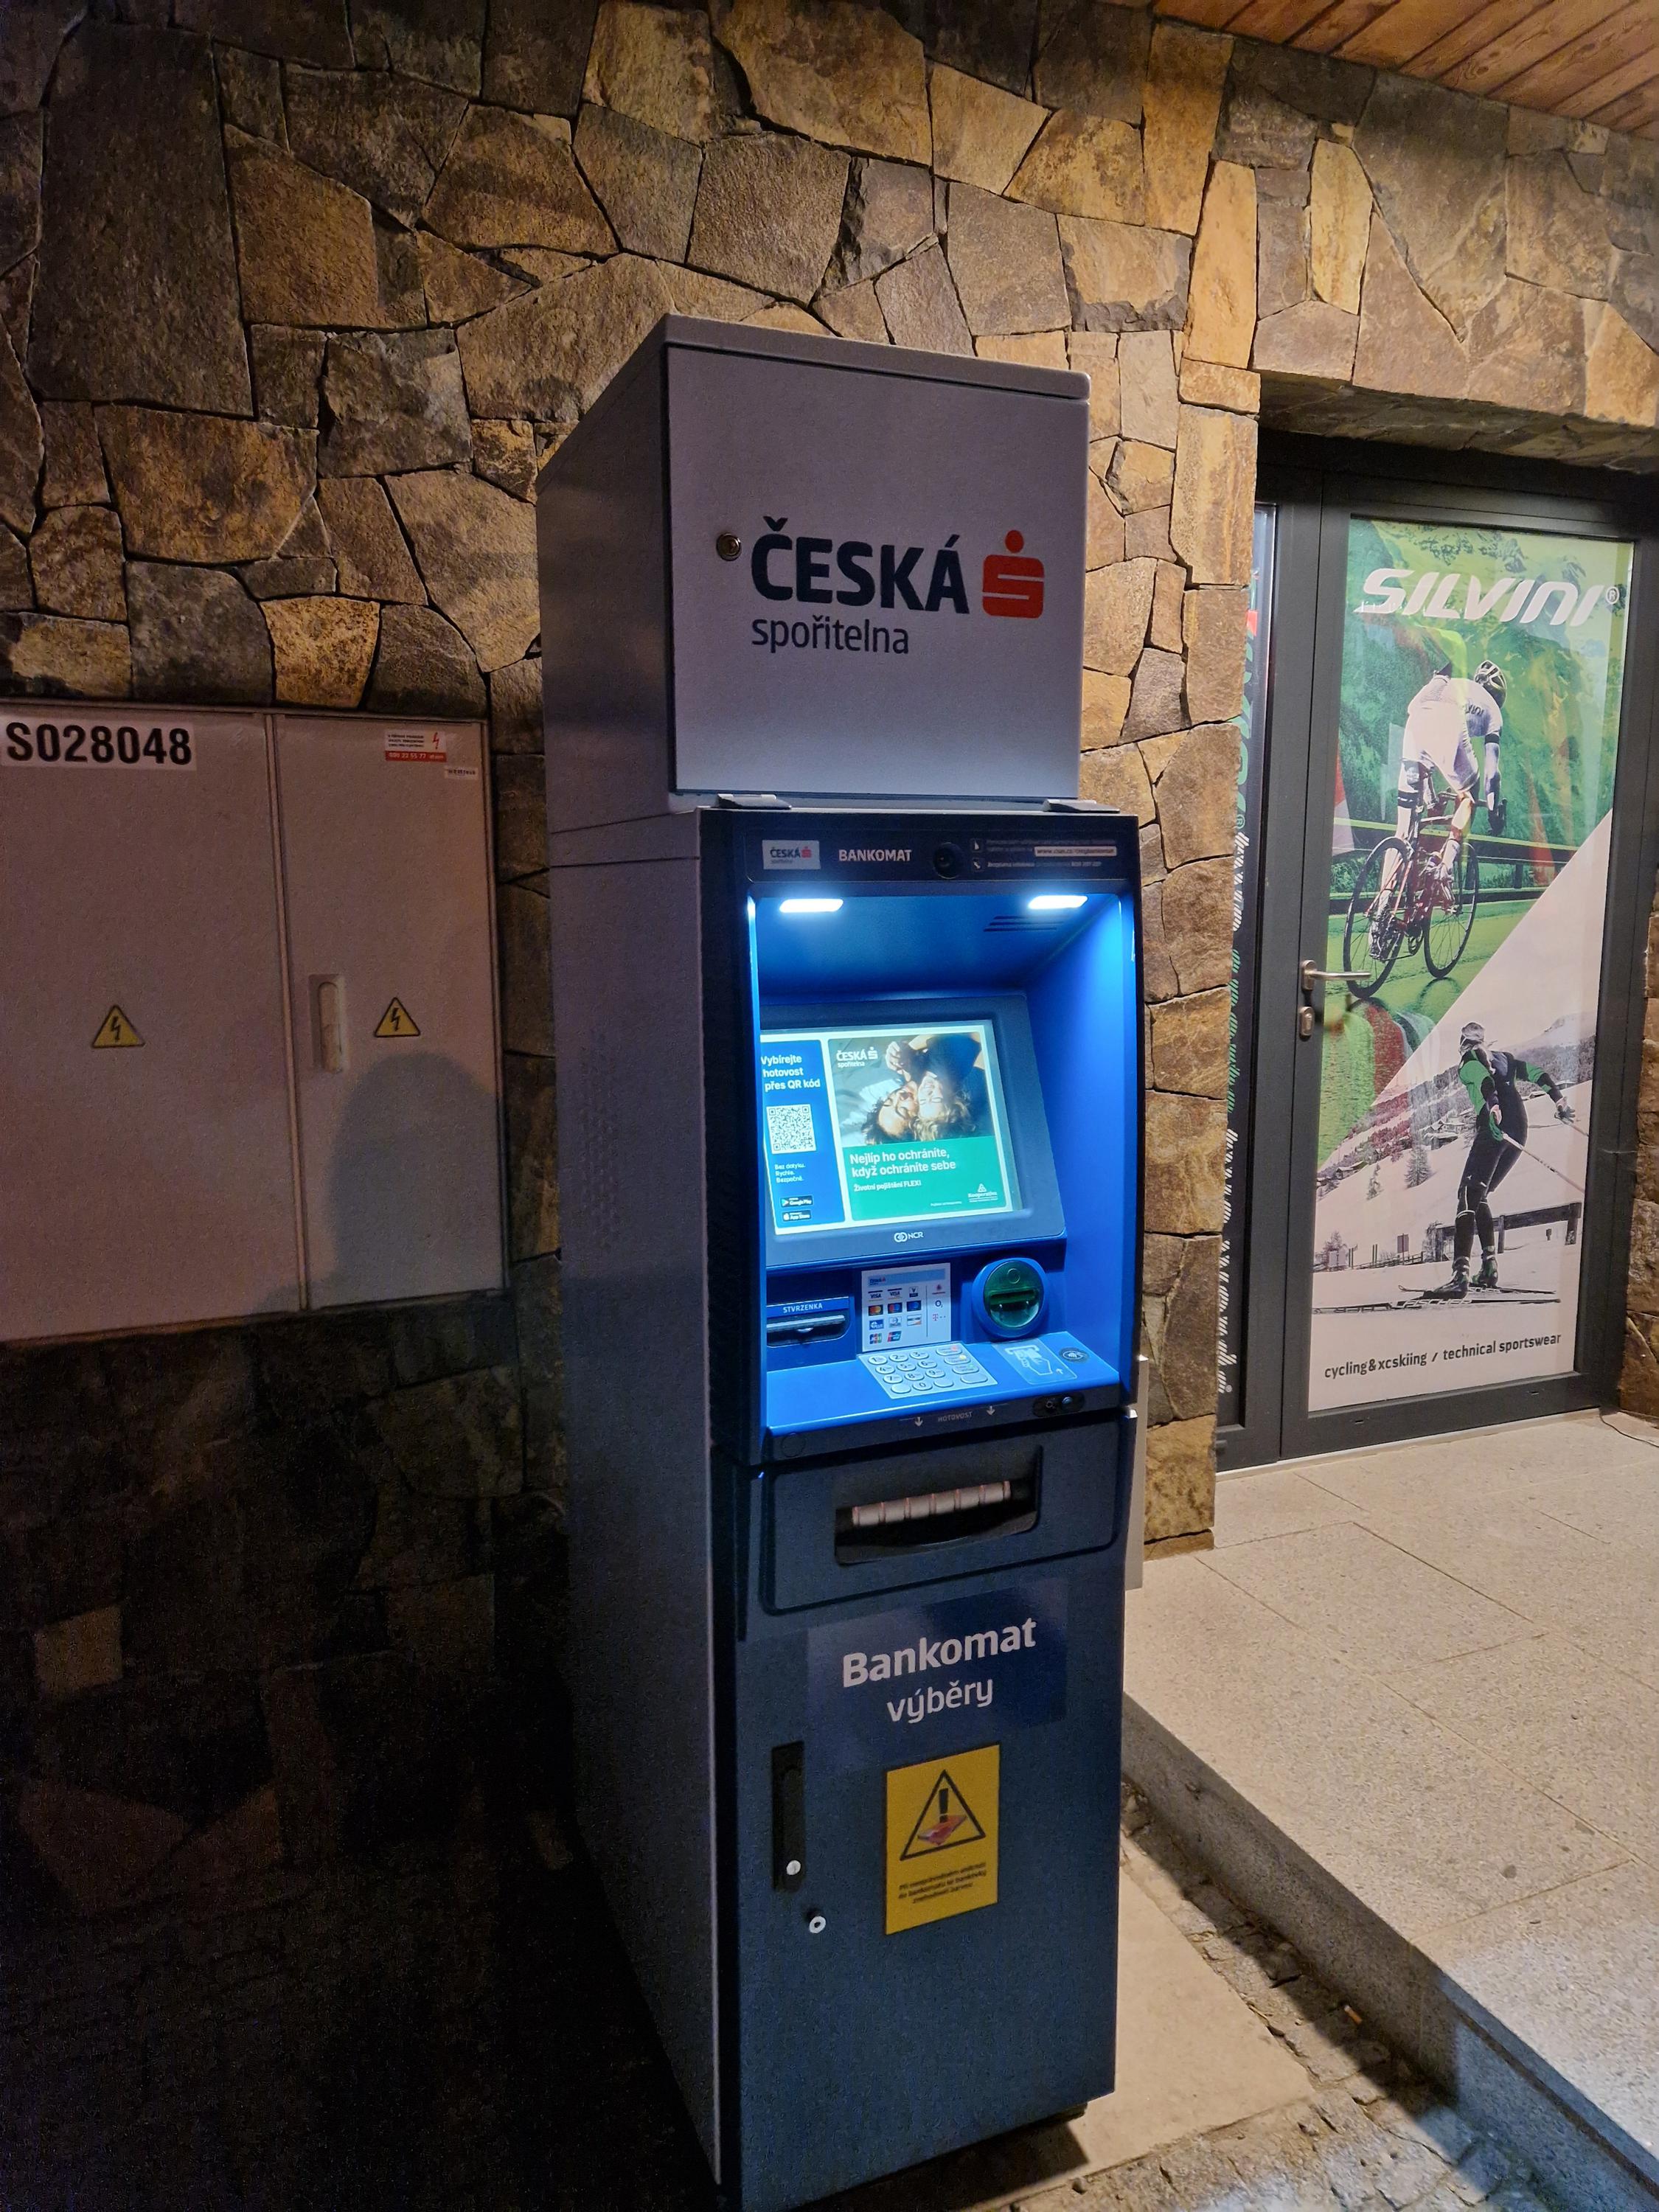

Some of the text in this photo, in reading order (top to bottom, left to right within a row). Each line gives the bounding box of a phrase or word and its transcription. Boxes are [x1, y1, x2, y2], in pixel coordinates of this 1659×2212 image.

[751, 516, 970, 614] ČESKÁ
[751, 615, 909, 654] spořitelna
[6, 722, 192, 765] S028048
[770, 846, 801, 858] ČESKÁ
[838, 849, 912, 862] BANKOMAT
[760, 1055, 802, 1067] Vybírejte
[836, 1048, 867, 1062] ČESKÁ
[762, 1067, 804, 1078] hotovost
[765, 1079, 821, 1092] přes QR kód
[849, 1147, 950, 1165] Nejlíp ho ochráníte,
[851, 1160, 956, 1179] když ochráníte sebe
[854, 1182, 876, 1192] Životní
[908, 1231, 924, 1239] NCR
[782, 1303, 823, 1313] STVRZENKA
[1403, 1298, 1472, 1308] FISCHER
[1443, 1340, 1497, 1360] technical
[1499, 1333, 1562, 1354] sportswear
[938, 1411, 973, 1422] HOTOVOST
[843, 1617, 1037, 1688] Bankomat
[887, 1678, 993, 1724] výběry
